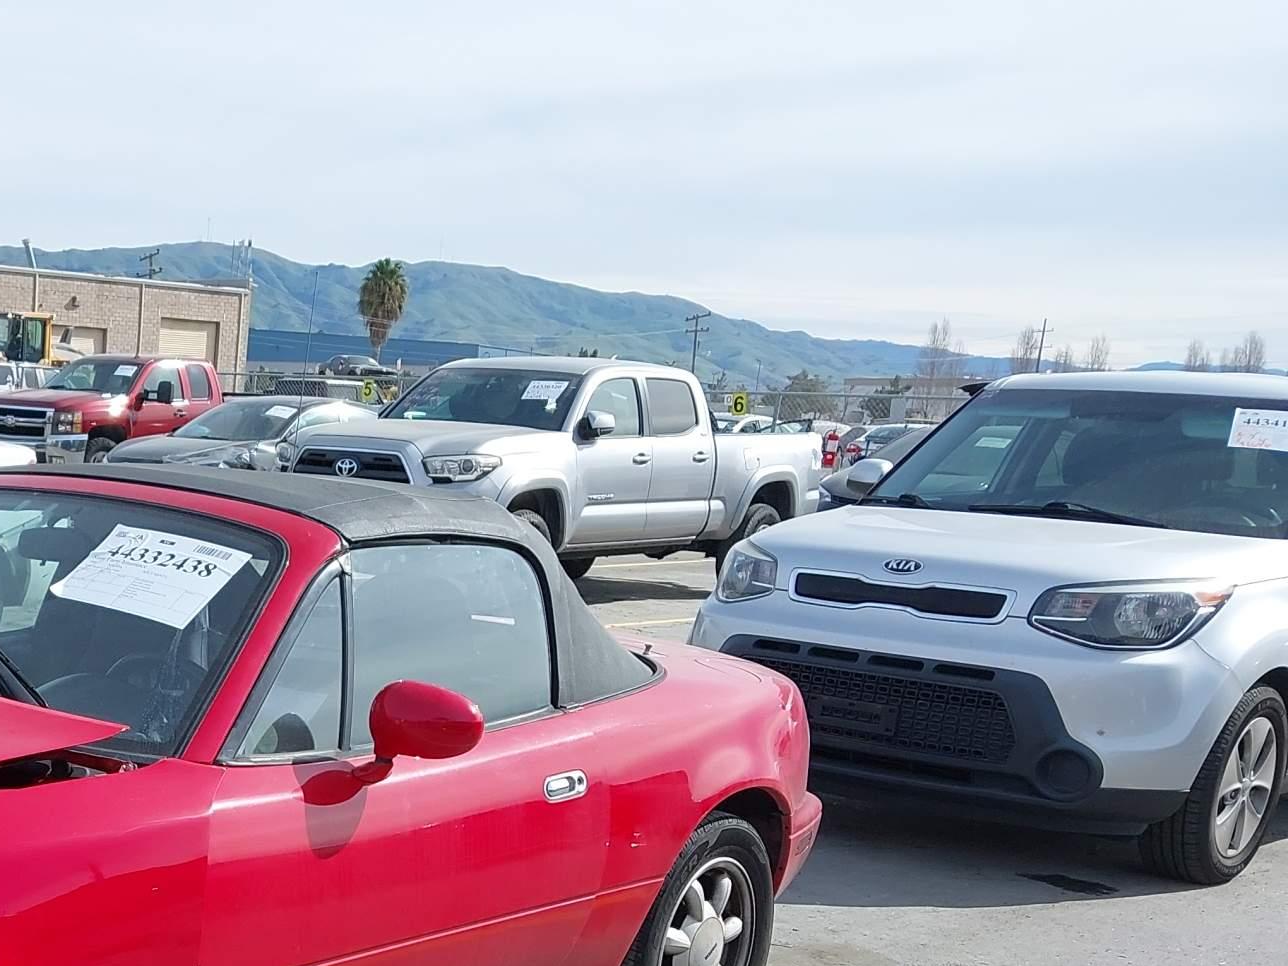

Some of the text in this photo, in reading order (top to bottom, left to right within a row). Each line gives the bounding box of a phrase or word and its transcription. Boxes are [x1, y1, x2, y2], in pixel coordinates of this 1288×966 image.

[363, 381, 372, 397] 5
[733, 395, 745, 413] 6
[108, 544, 217, 577] 44332438
[887, 559, 916, 571] KIA
